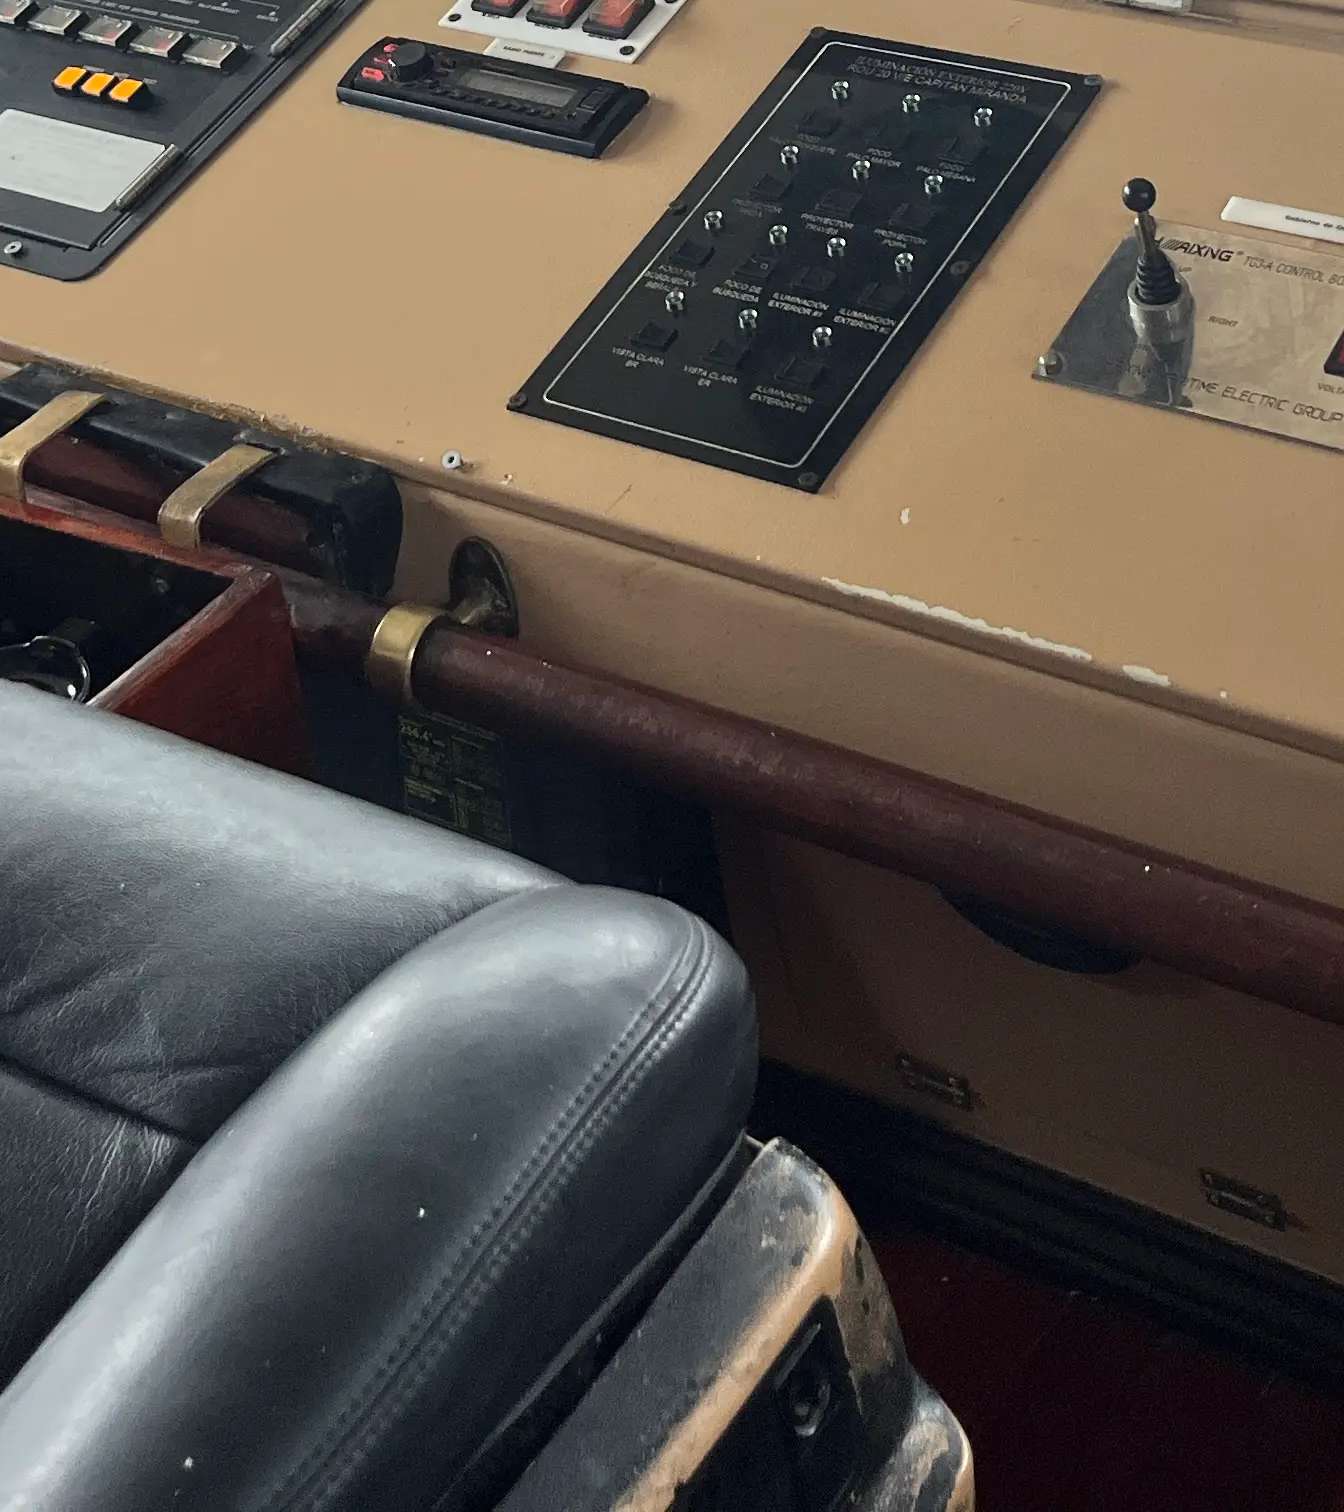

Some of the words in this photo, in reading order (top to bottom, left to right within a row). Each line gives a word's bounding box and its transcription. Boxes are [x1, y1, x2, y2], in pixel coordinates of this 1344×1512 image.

[969, 87, 1027, 104] MIRANDA
[1275, 262, 1325, 283] CONTROL
[767, 299, 812, 316] EXTERIOR
[833, 315, 879, 332] EXTERIOR
[1207, 315, 1239, 328] RIGHT
[612, 346, 636, 359] VISTA
[636, 352, 665, 366] CLARA
[683, 364, 708, 378] VISTA
[708, 371, 738, 385] CLARA
[1221, 386, 1291, 412] ELECTRIC
[1292, 402, 1344, 424] GROUP
